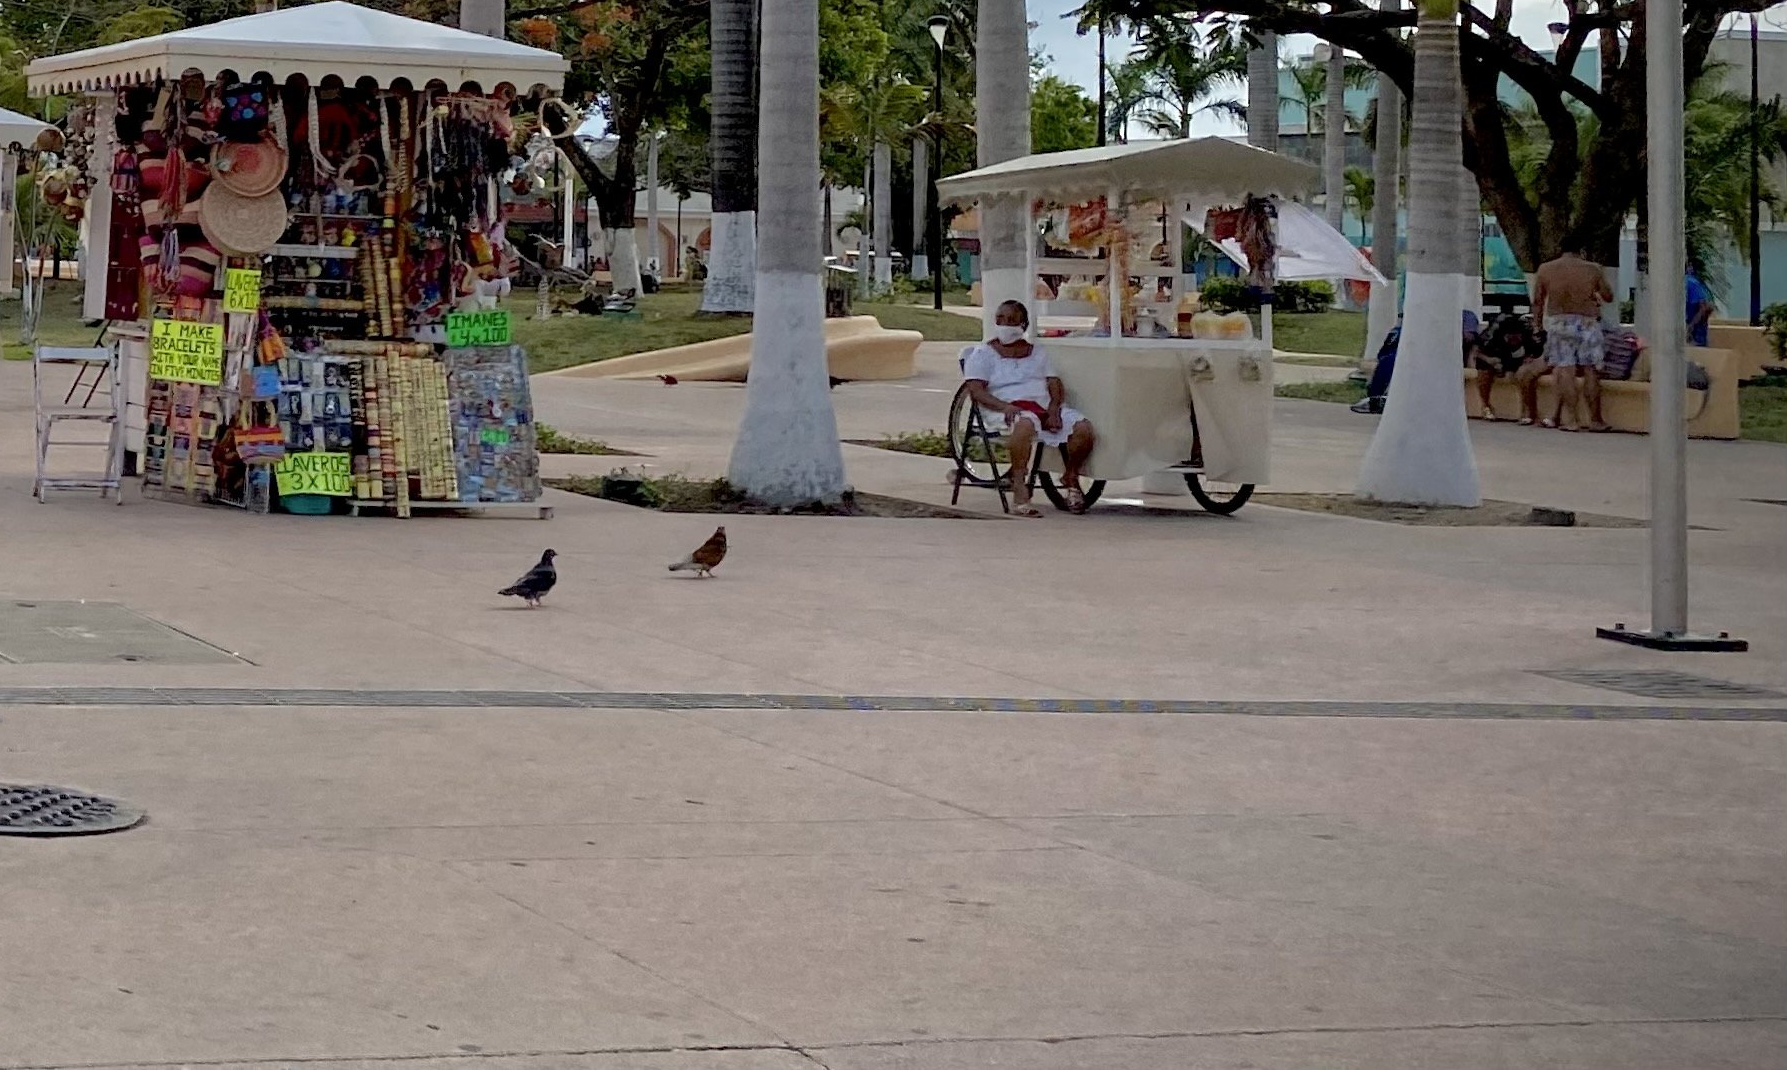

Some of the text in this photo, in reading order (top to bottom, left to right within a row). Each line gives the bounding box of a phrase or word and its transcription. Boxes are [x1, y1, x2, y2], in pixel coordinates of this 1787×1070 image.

[450, 312, 508, 330] IMANES
[162, 322, 215, 340] I MAKE
[153, 336, 216, 356] BRACELETS
[276, 455, 350, 475] LLAVEROS
